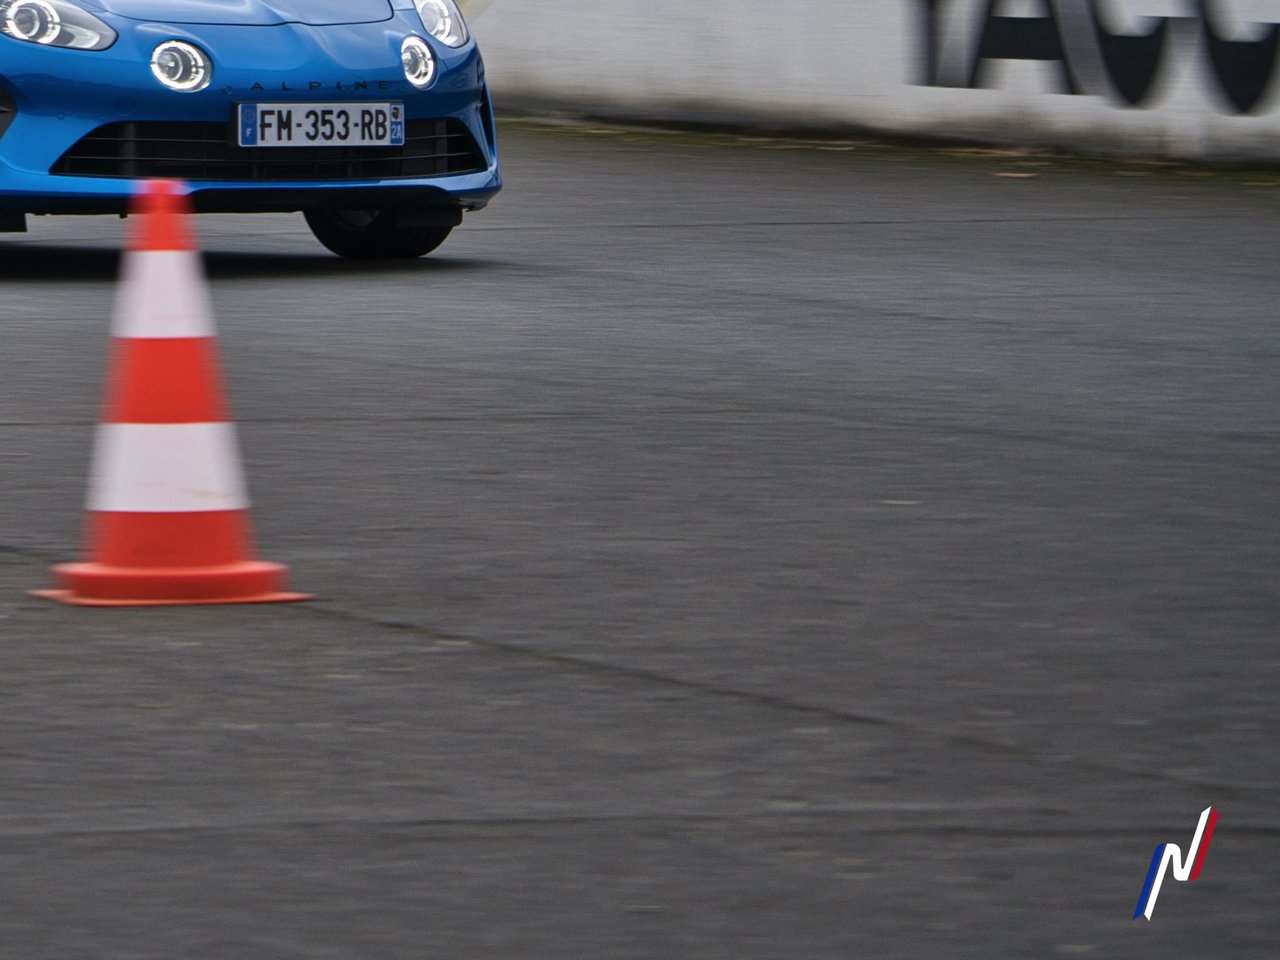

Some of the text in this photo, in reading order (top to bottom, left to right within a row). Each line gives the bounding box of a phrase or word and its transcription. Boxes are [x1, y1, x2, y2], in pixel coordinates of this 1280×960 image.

[251, 81, 389, 91] ALPINE
[260, 110, 387, 141] FM-353-RB
[391, 124, 402, 139] 2A
